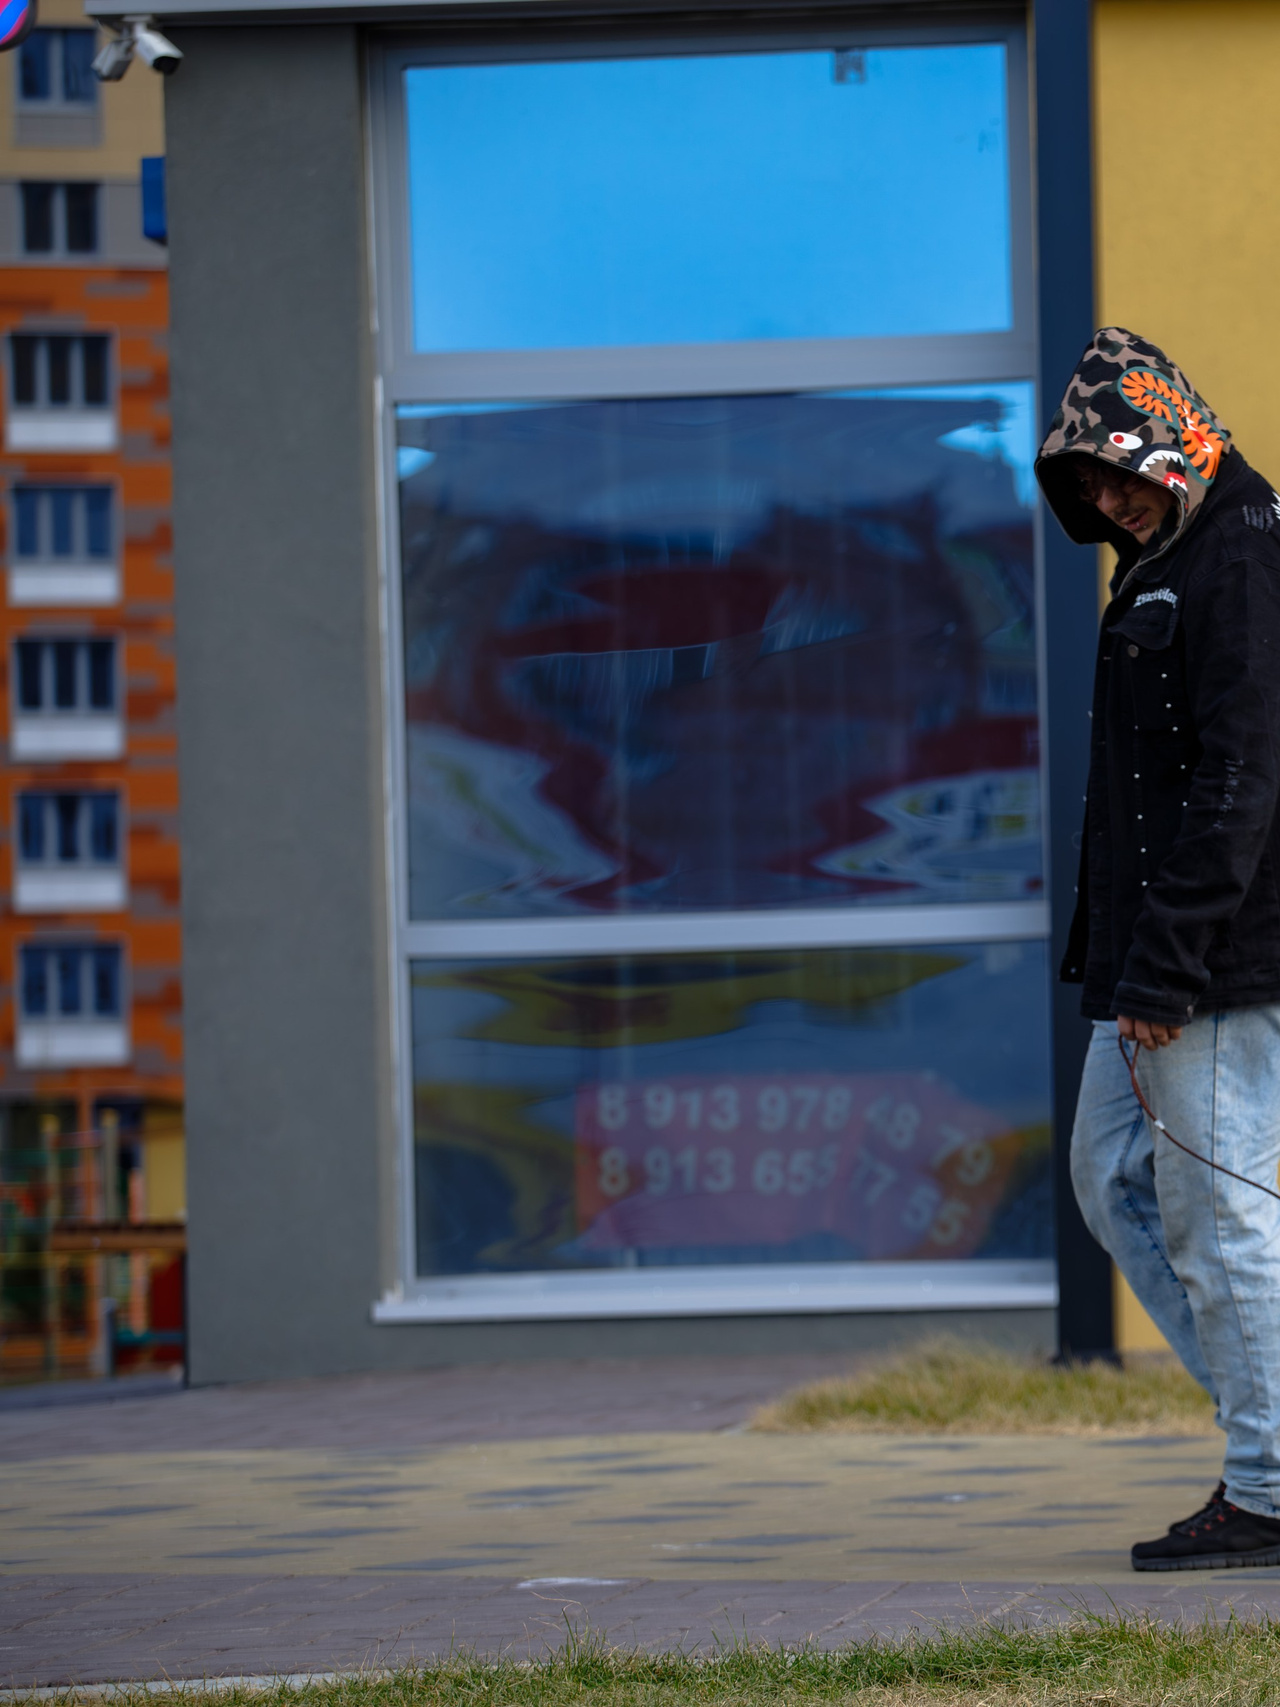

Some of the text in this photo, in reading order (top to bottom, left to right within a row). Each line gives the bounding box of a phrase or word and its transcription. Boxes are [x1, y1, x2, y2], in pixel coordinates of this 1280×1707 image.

[598, 1085, 627, 1130] 8
[644, 1084, 740, 1132] 913
[757, 1085, 851, 1133] 978
[931, 1123, 992, 1185] 79
[599, 1147, 627, 1196] 8
[644, 1144, 735, 1196] 913
[902, 1186, 970, 1246] 55
